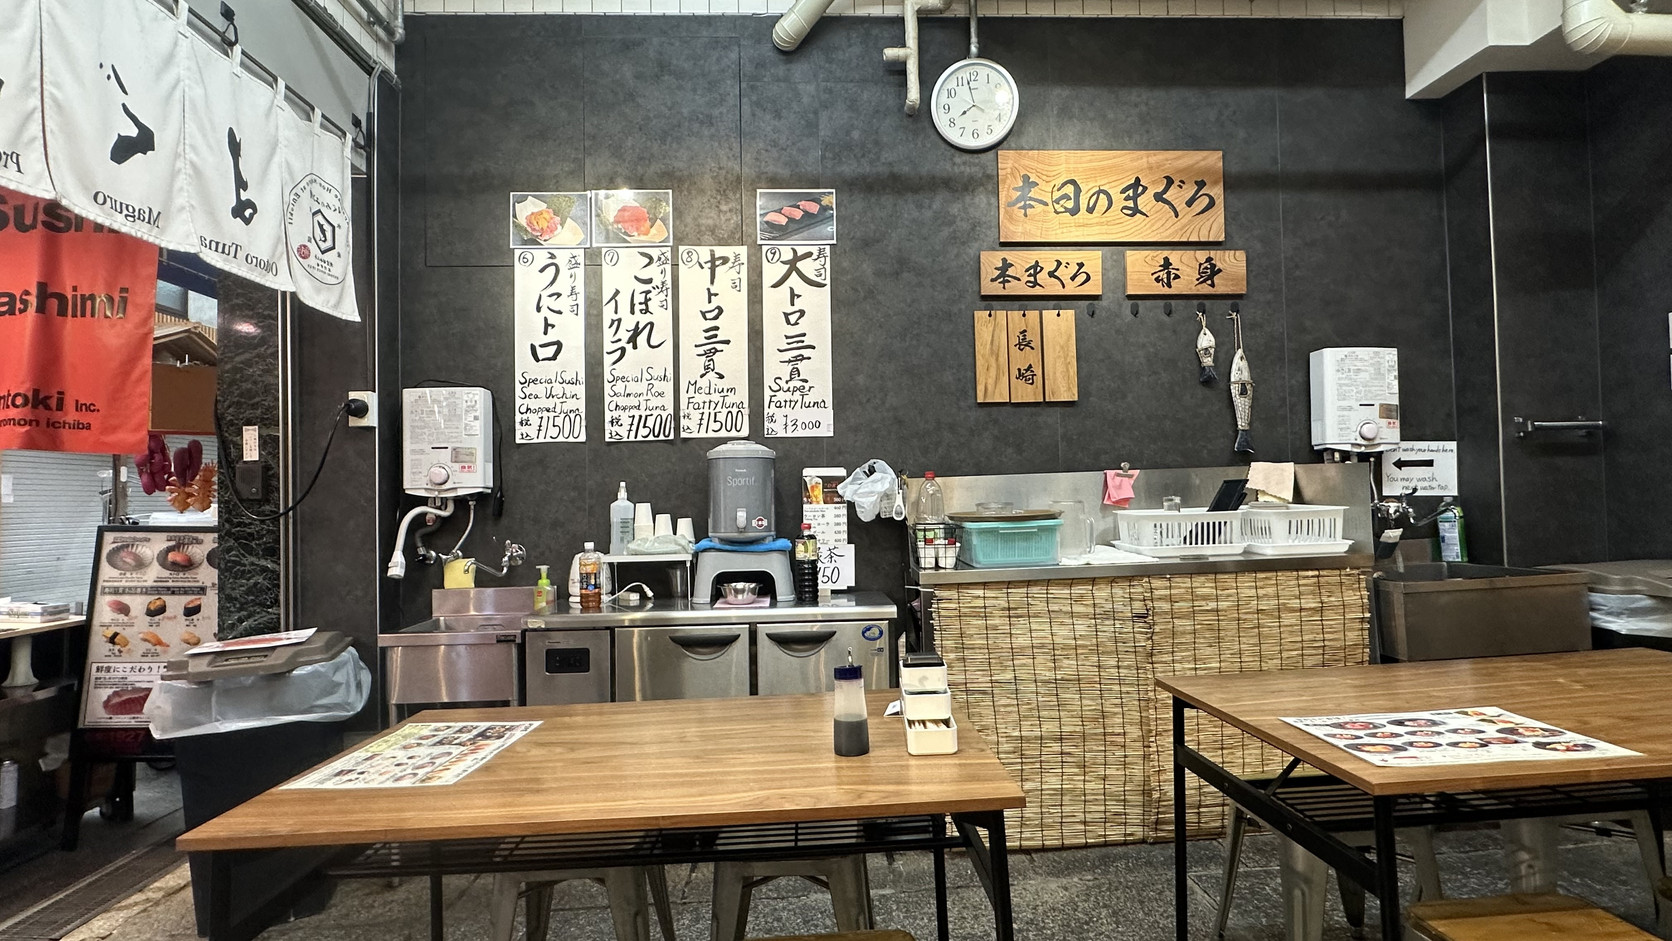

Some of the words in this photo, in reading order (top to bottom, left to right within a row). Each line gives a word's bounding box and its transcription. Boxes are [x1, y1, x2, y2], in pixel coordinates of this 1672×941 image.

[956, 76, 964, 87] 11
[969, 70, 979, 82] 12
[986, 73, 990, 84] 1
[946, 87, 957, 99] 10
[942, 103, 950, 114] 9
[948, 118, 956, 128] 8
[986, 125, 993, 135] 5
[959, 127, 966, 137] 7
[971, 128, 980, 139] 6
[1006, 173, 1216, 219] 本日のまぐろ
[812, 247, 829, 281] 寿司
[727, 252, 744, 292] 寿司
[990, 257, 1092, 290] 本まぐろ
[1150, 255, 1223, 289] 赤身
[530, 251, 563, 363] うにトロ
[625, 251, 667, 350] こぼれ
[694, 248, 731, 380] 中トロ三貫
[770, 247, 828, 384] 大トロ三貫
[604, 288, 627, 366] イクラ
[1013, 329, 1037, 385] 長崎
[518, 371, 558, 387] Special
[560, 371, 584, 386] Sushi
[607, 367, 643, 384] Special
[646, 366, 672, 382] Sushi
[518, 386, 542, 400] Sea
[608, 385, 644, 398] Salmon
[646, 383, 665, 398] Roe
[686, 379, 736, 395] Medium
[768, 376, 815, 396] Super
[75, 400, 100, 413] Inc.
[518, 403, 557, 415] Chopped
[558, 401, 583, 415] Tuna
[608, 400, 641, 413] Chopped
[643, 399, 668, 412] Tuna
[46, 417, 92, 431] ichiba
[726, 475, 755, 488] Sportif
[1385, 473, 1398, 483] You
[1416, 472, 1438, 483] wash
